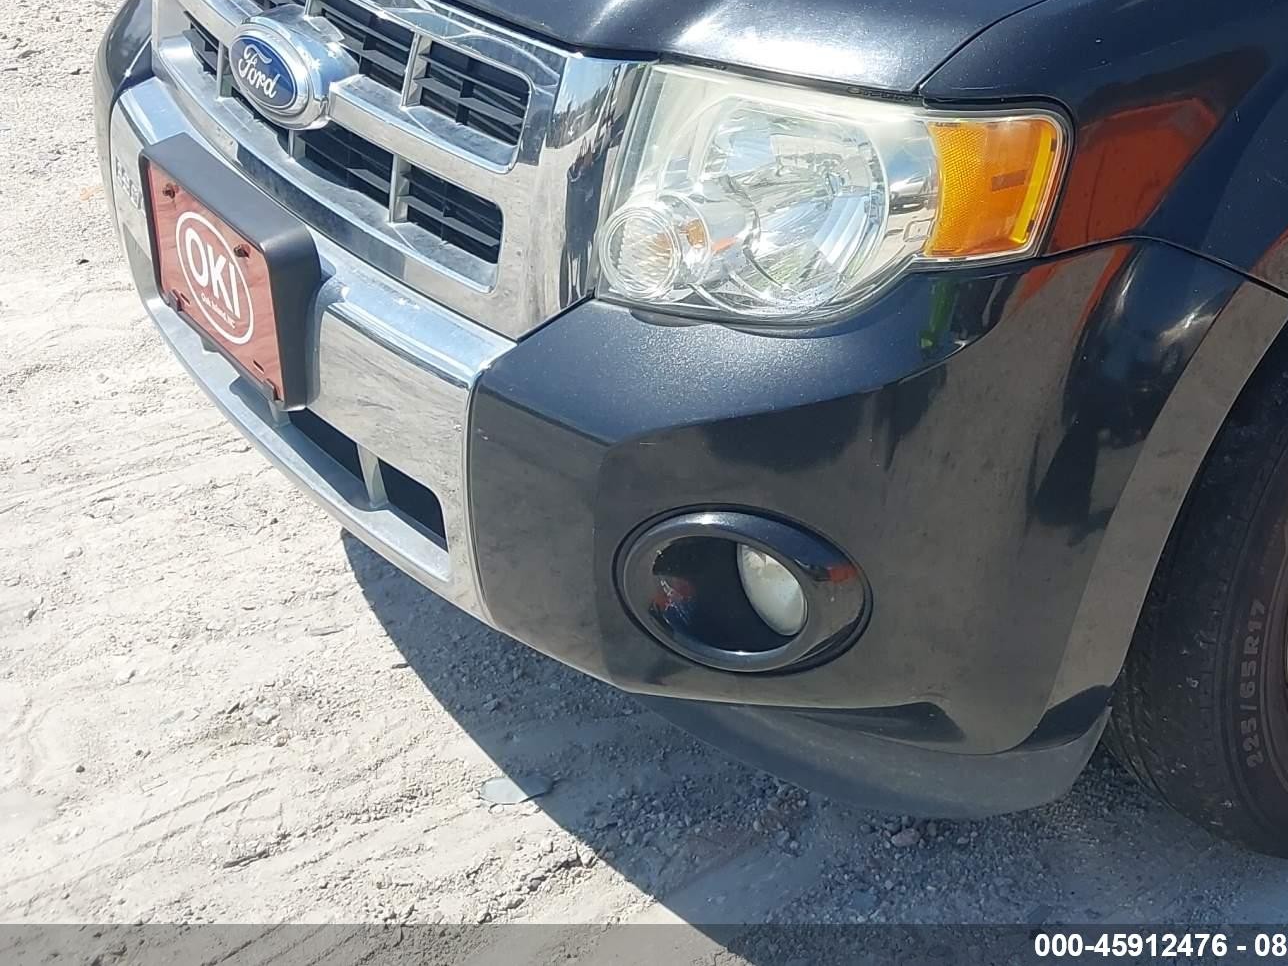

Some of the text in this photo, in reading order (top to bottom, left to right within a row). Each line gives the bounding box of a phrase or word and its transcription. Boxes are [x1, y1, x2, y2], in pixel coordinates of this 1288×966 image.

[238, 44, 281, 99] Ford
[184, 227, 241, 321] OKI
[1239, 598, 1265, 768] 225/65R17
